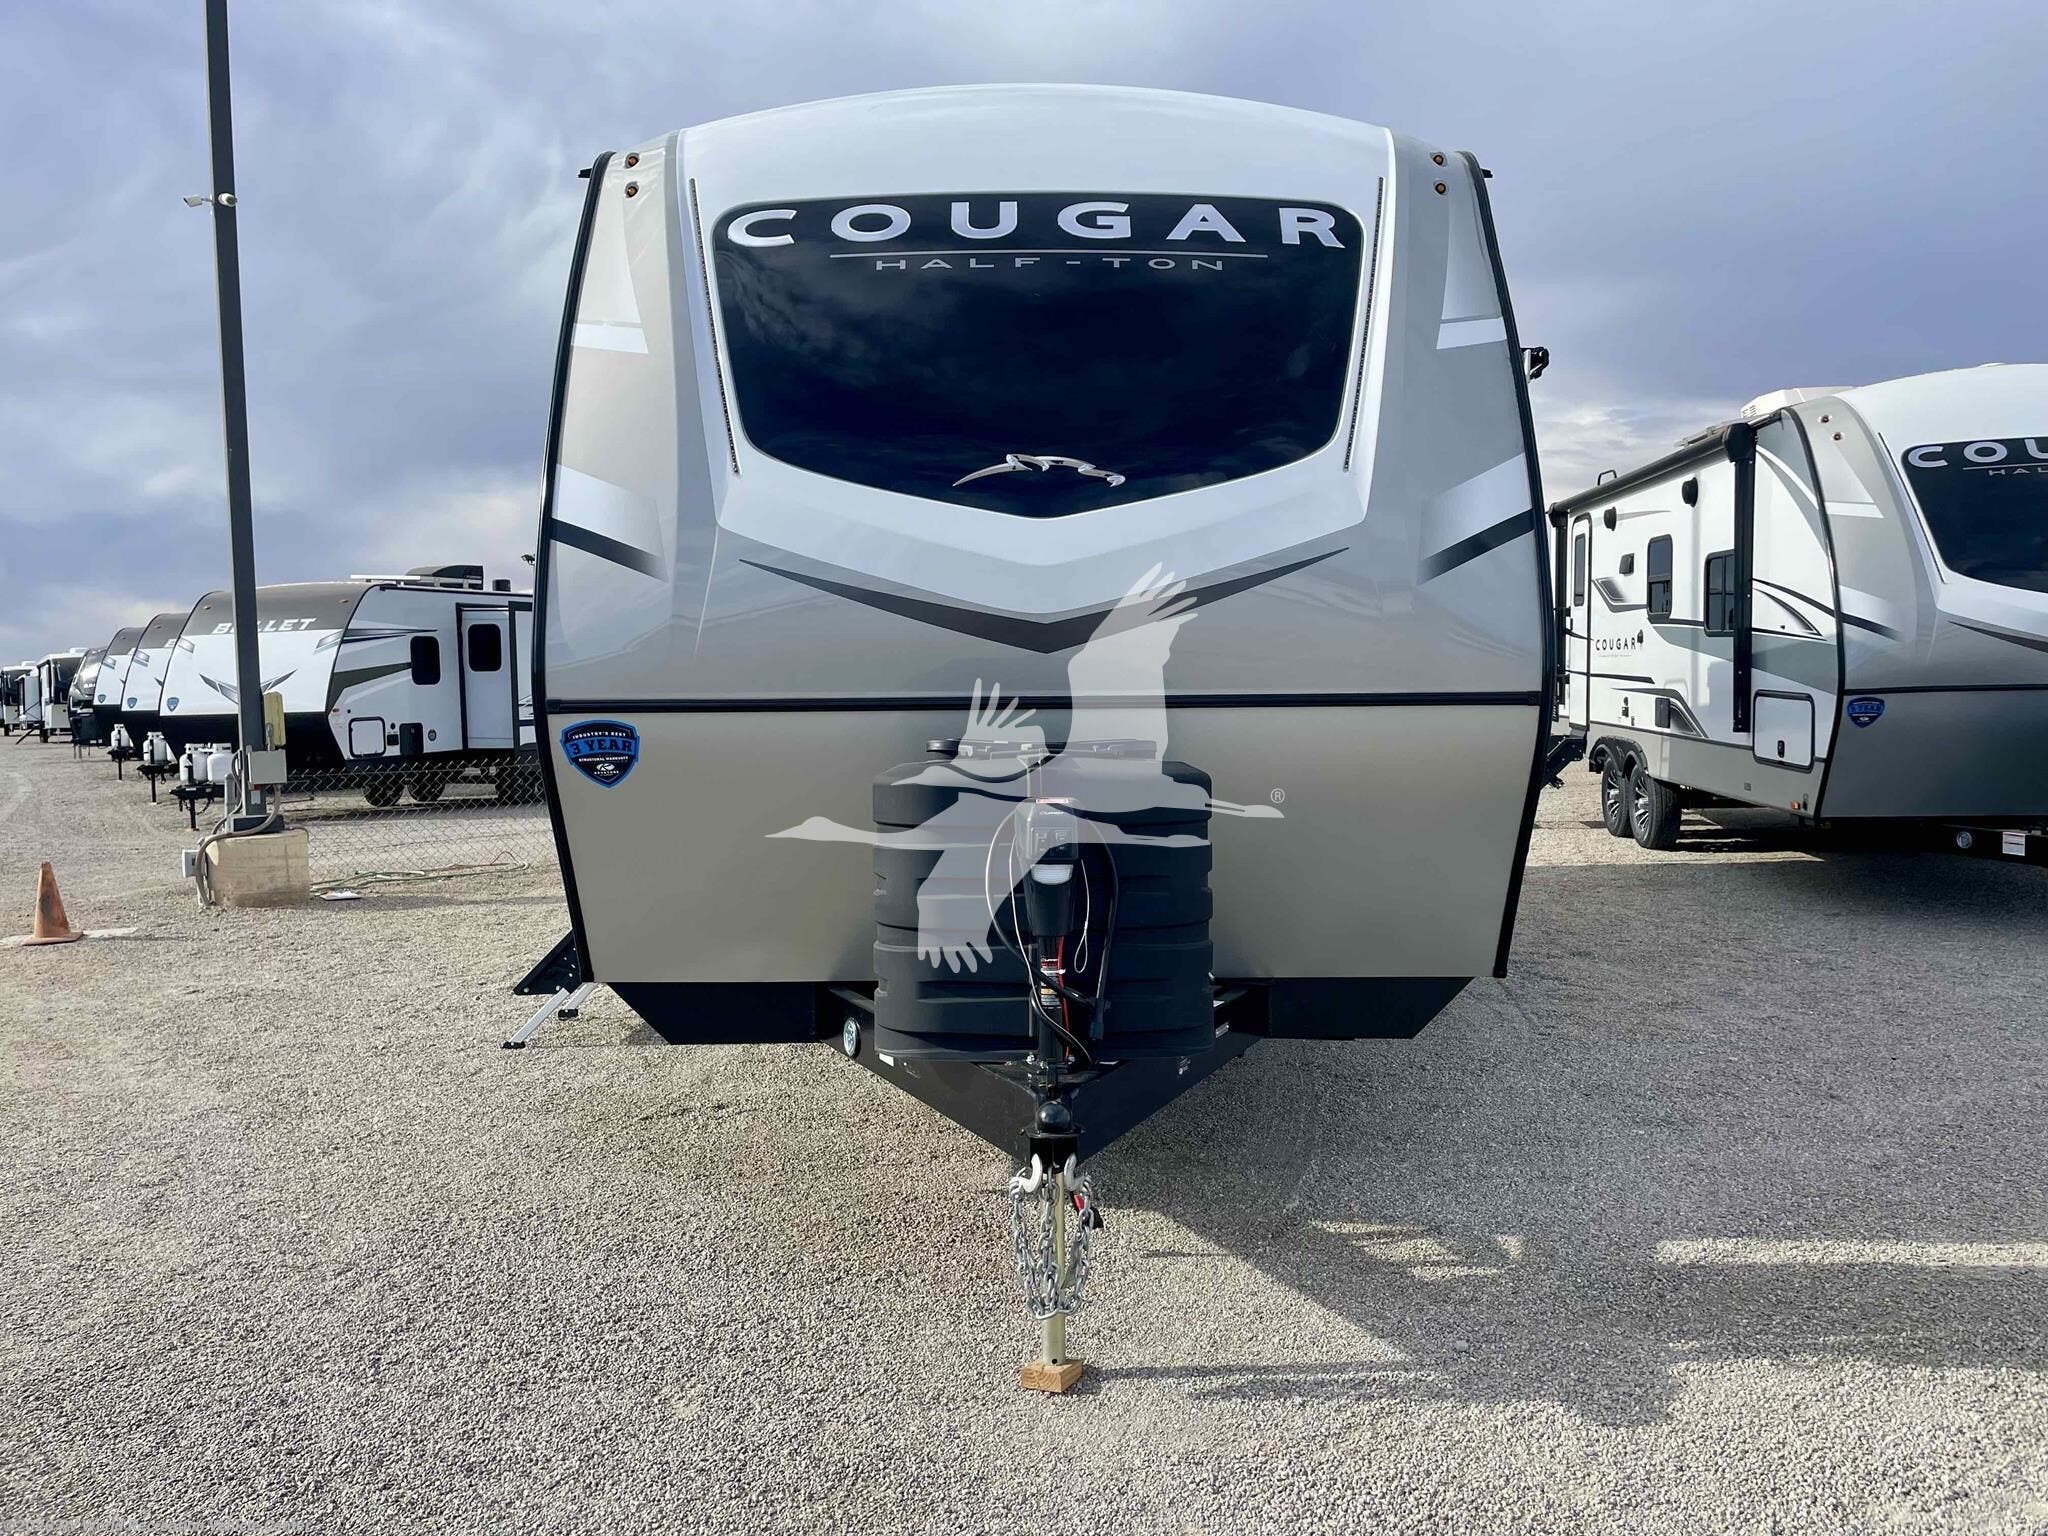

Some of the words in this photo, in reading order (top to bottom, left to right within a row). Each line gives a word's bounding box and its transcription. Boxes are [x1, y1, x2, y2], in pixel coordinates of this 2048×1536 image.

[727, 200, 1346, 249] COUGAR
[211, 617, 317, 634] BLLET
[1595, 637, 1636, 651] COUGAR
[570, 742, 581, 755] 3
[585, 739, 632, 752] YEAR
